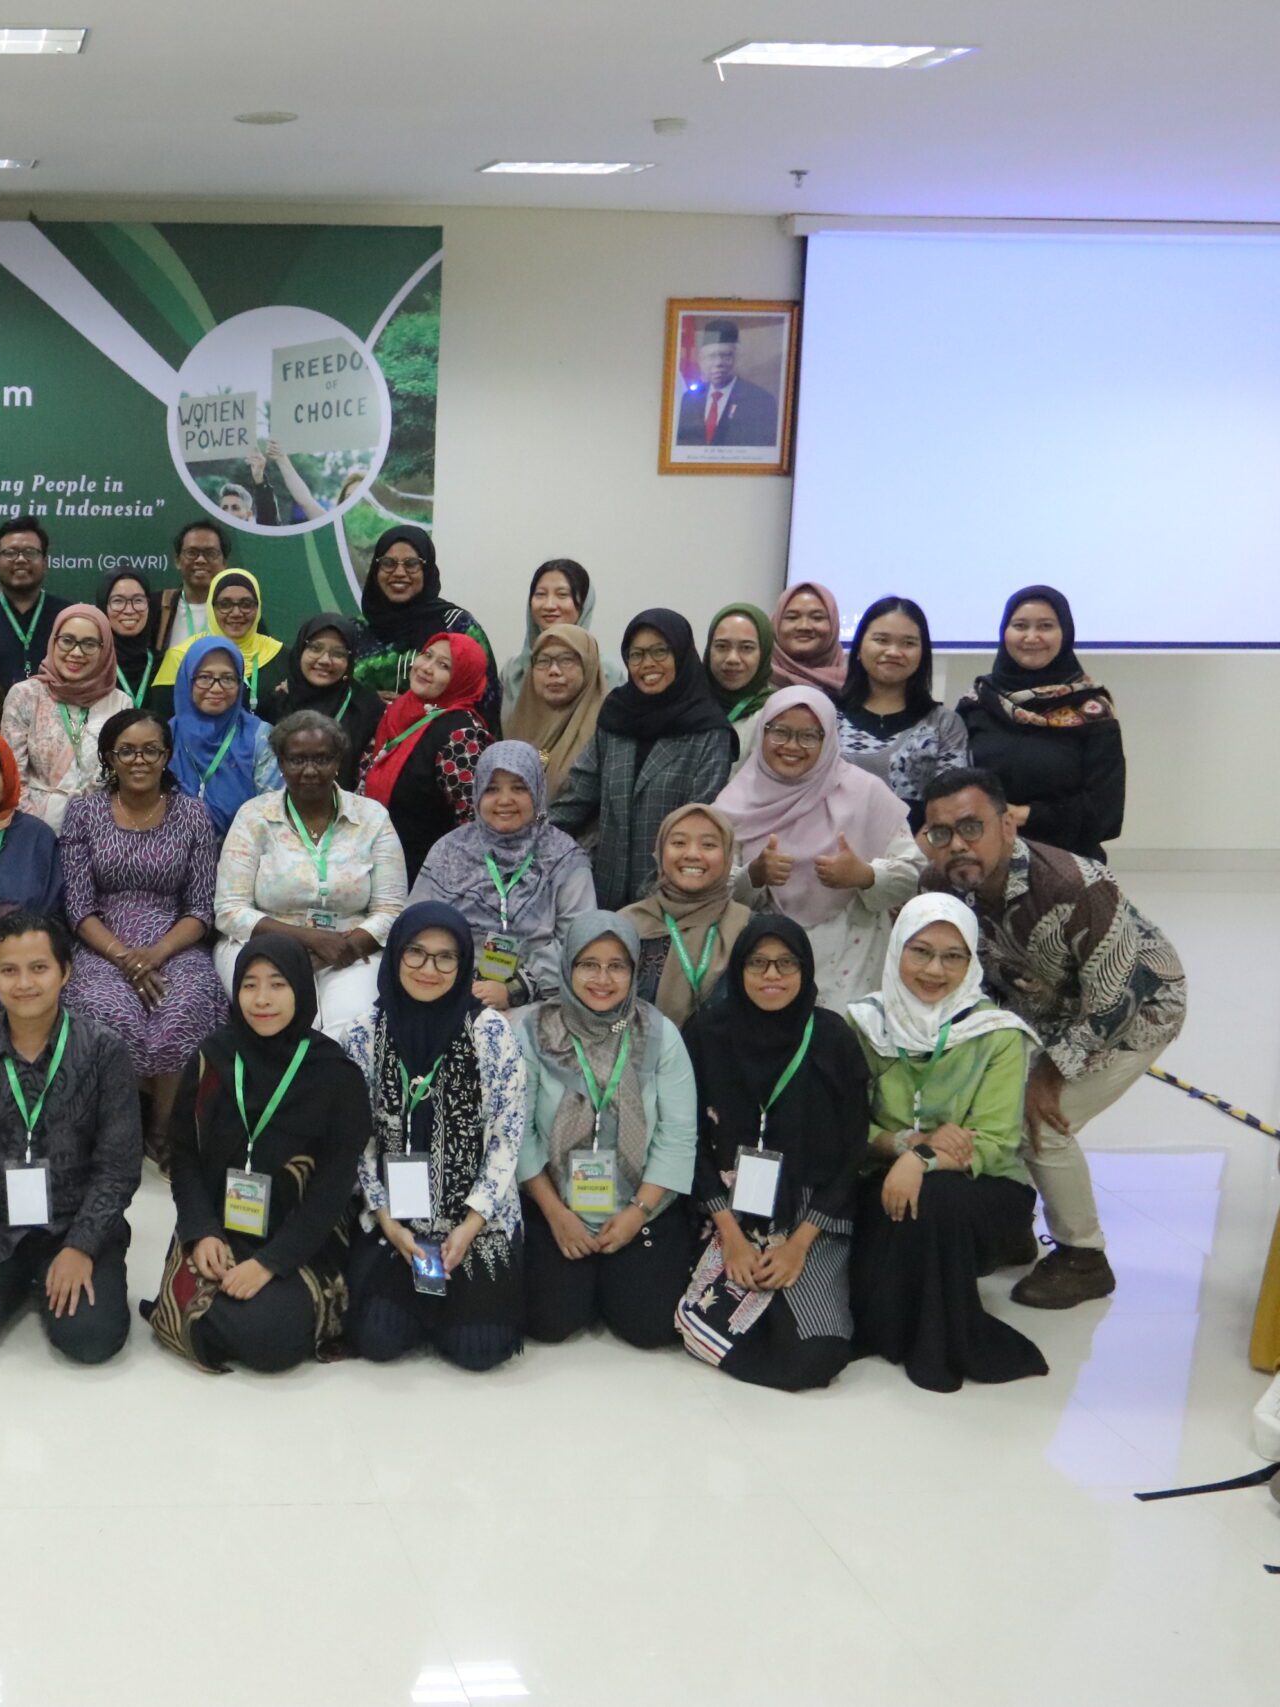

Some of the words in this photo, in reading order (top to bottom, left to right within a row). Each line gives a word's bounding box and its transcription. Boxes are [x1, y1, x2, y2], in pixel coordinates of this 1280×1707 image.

[282, 350, 369, 382] FREEDO
[325, 380, 338, 390] OF
[178, 400, 245, 429] WOMEN
[294, 397, 368, 424] CHOICE
[185, 427, 249, 450] POWER
[32, 475, 96, 496] People
[104, 475, 124, 492] in
[28, 499, 48, 516] in
[56, 499, 165, 517] Indonesia”
[48, 554, 93, 569] Islam
[98, 554, 169, 571] (GCWRI)
